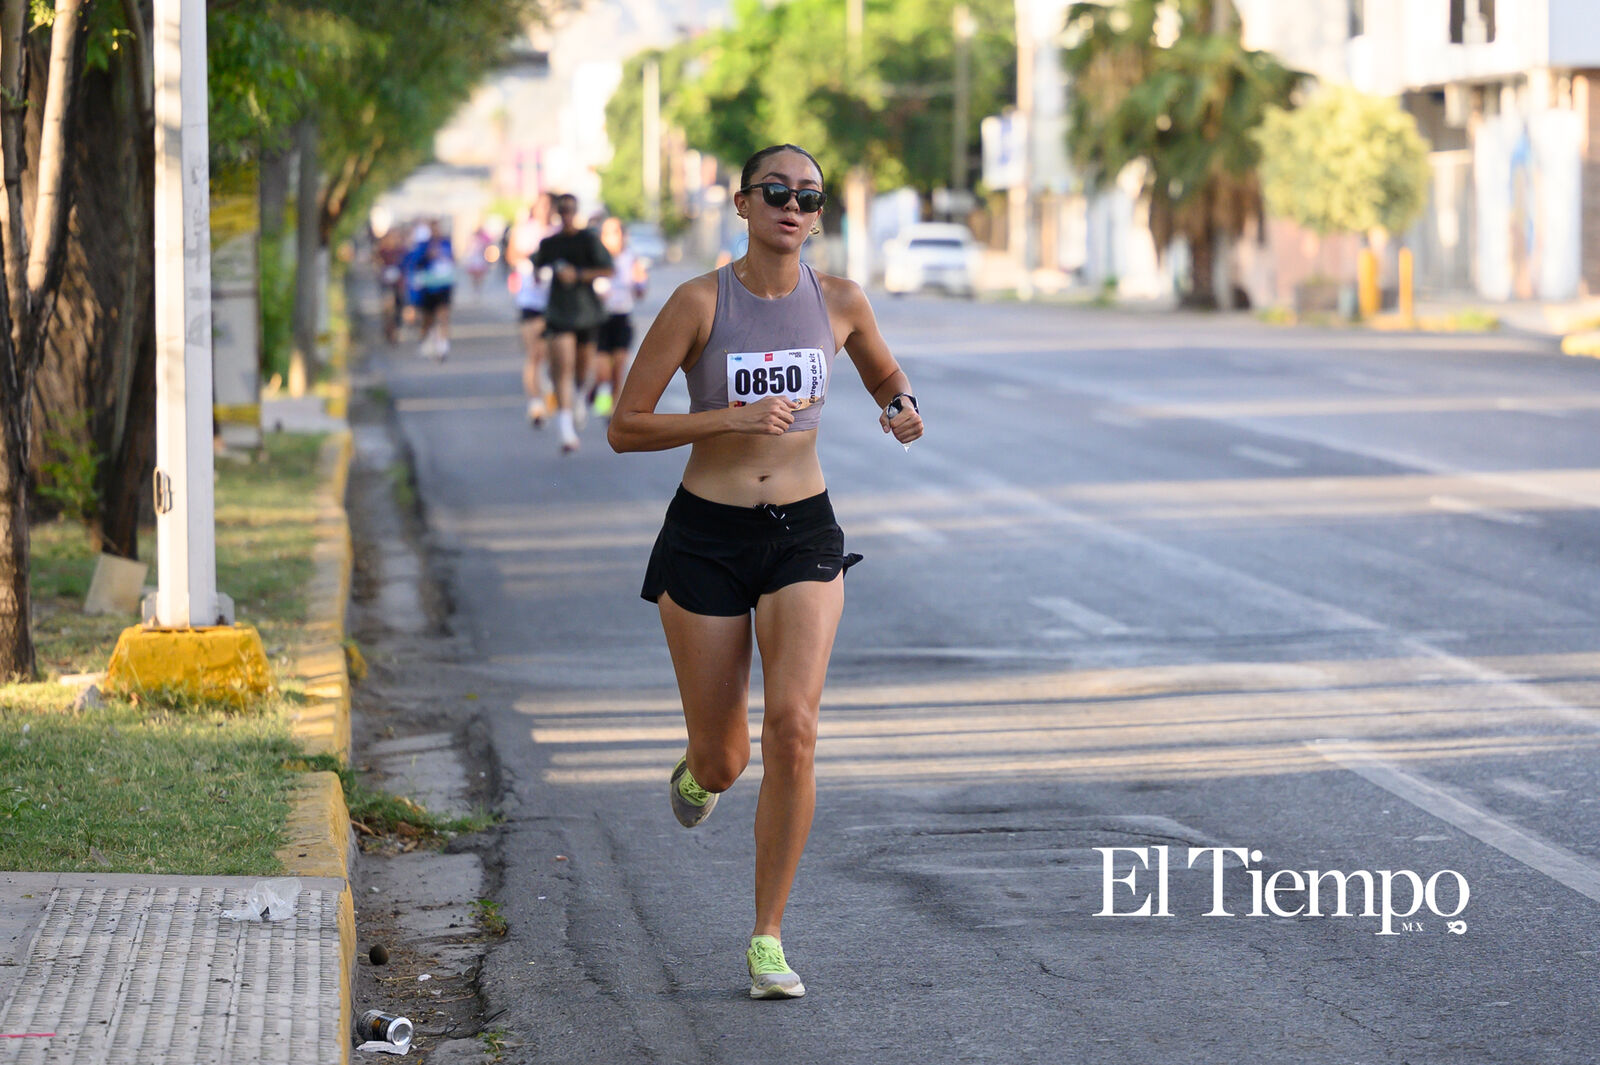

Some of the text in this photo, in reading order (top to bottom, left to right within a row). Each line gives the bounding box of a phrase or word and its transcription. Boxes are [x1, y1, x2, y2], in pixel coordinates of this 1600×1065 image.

[735, 364, 802, 396] 0850
[810, 364, 817, 375] de
[809, 376, 818, 404] Entrega
